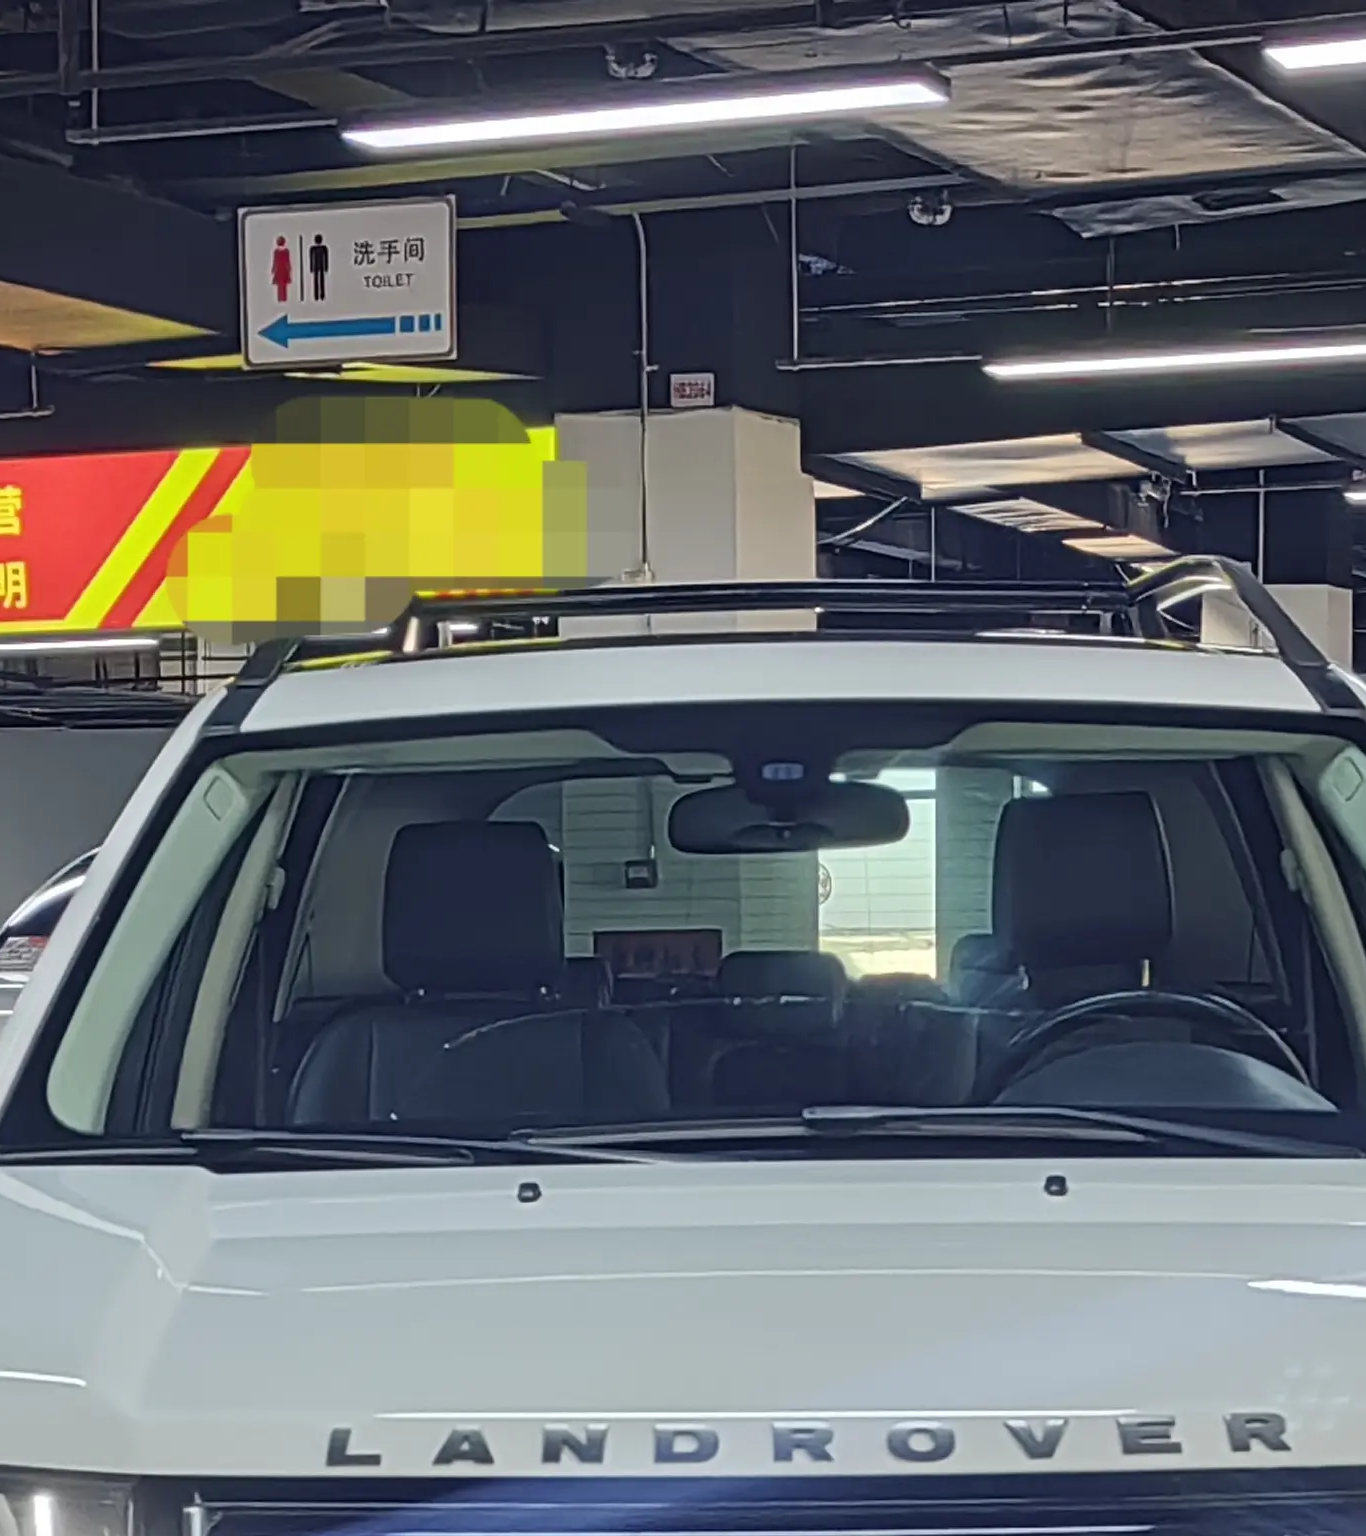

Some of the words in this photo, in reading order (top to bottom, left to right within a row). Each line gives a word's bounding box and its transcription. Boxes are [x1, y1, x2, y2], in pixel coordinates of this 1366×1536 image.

[353, 237, 425, 266] 洗手间
[363, 273, 414, 289] TOILET
